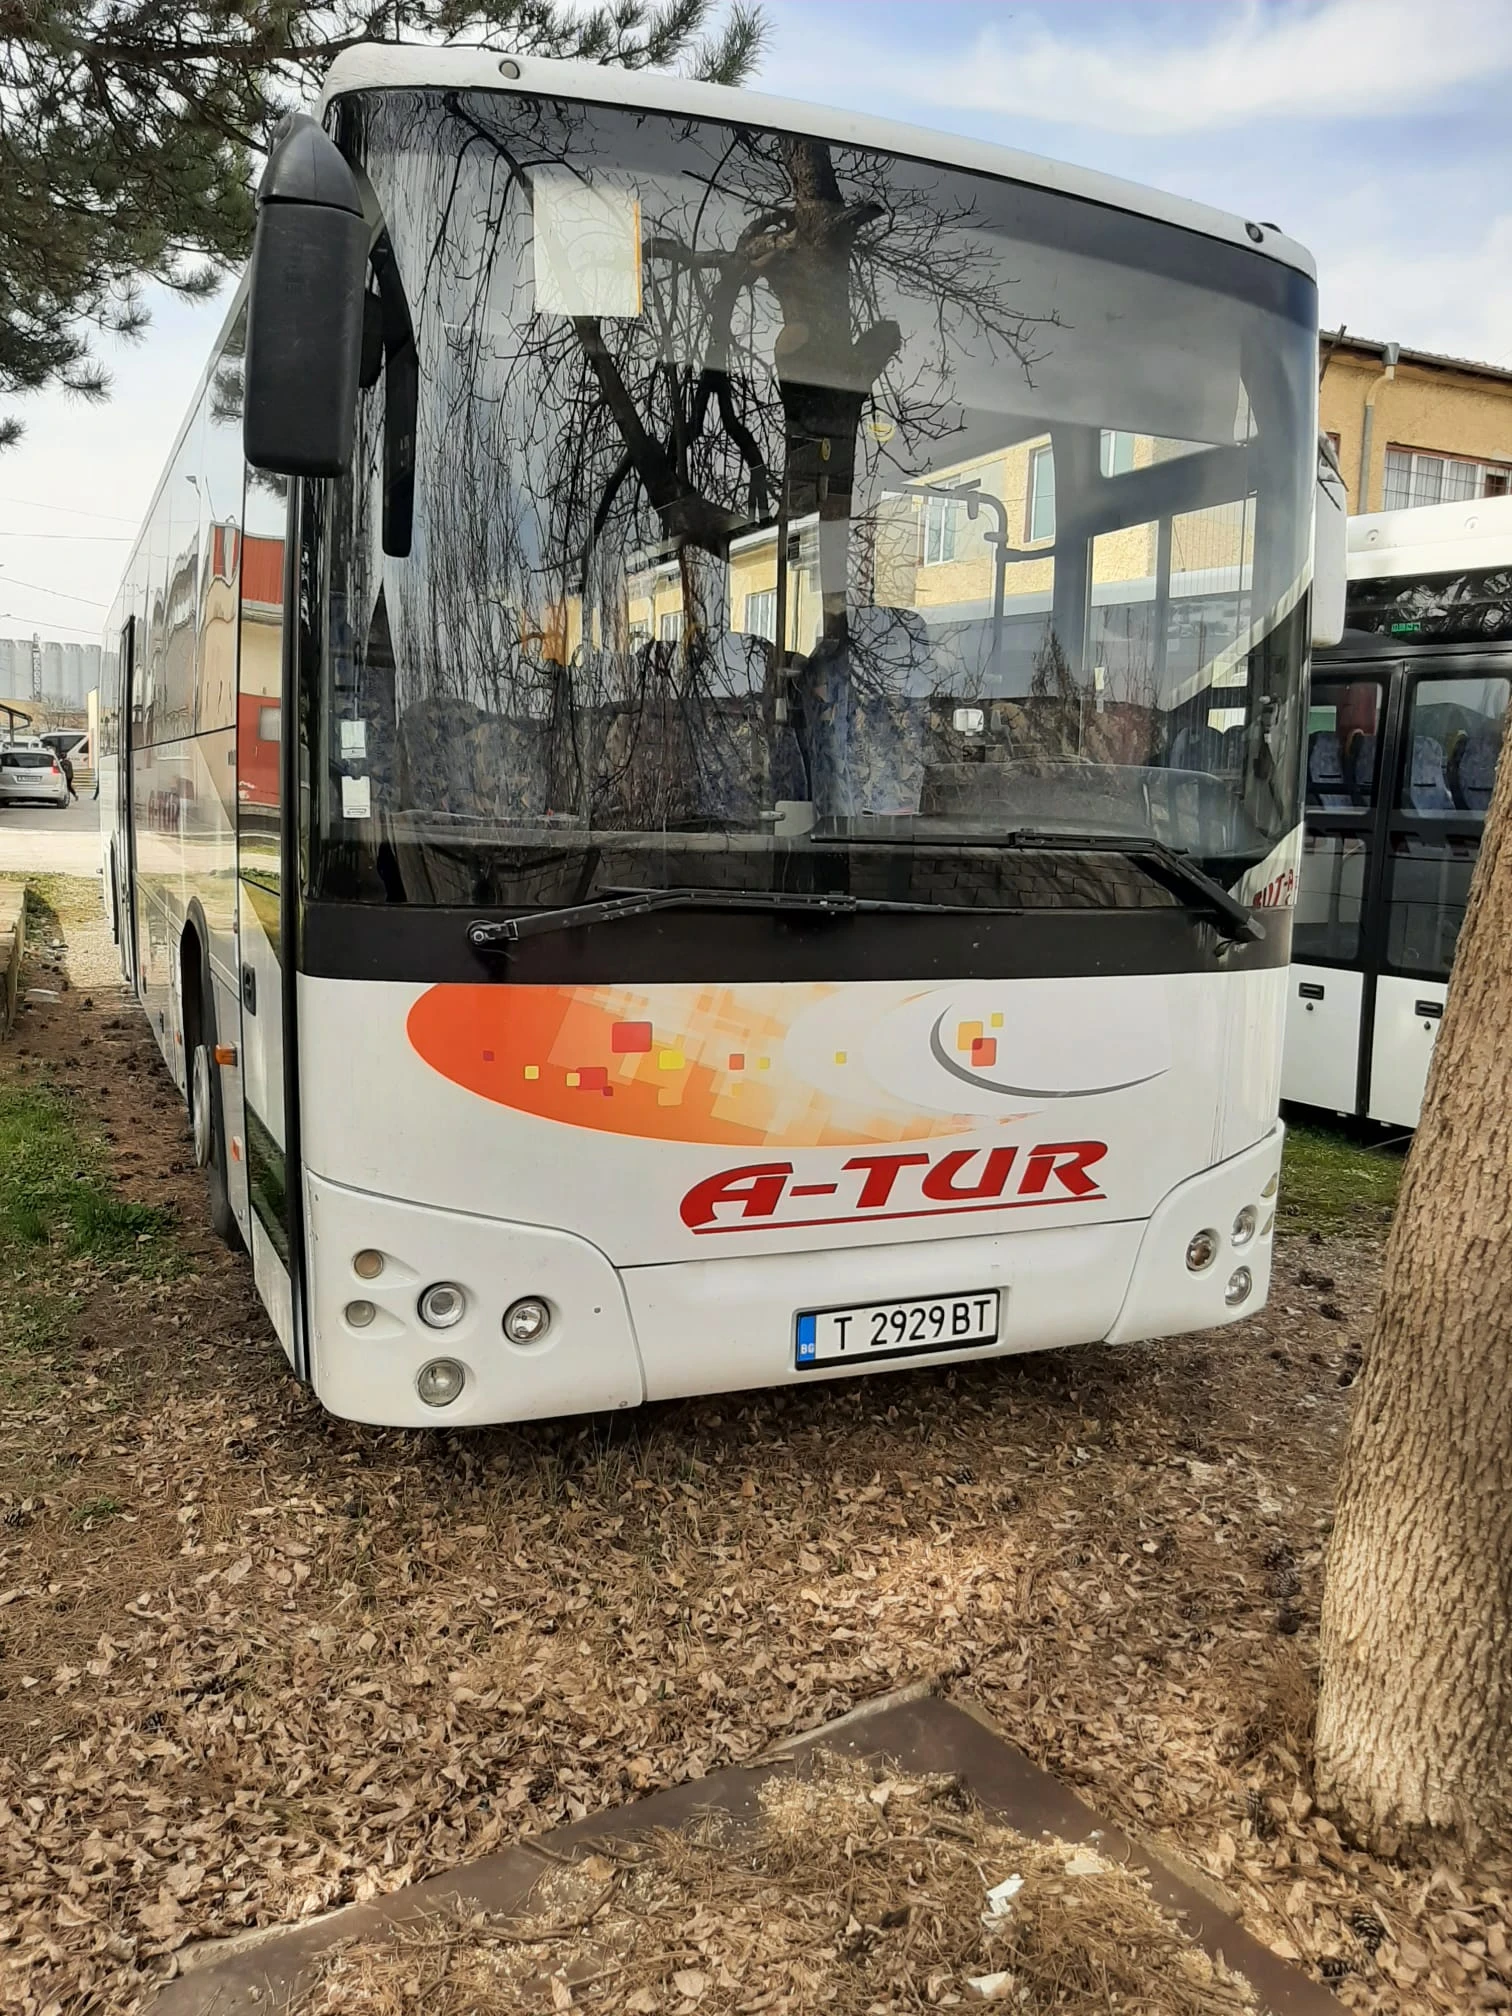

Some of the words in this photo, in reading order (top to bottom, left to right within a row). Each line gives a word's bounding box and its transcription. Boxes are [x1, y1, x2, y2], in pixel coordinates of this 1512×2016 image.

[680, 1140, 1109, 1229] A-TUR
[800, 1343, 815, 1355] BG
[834, 1316, 853, 1350] T
